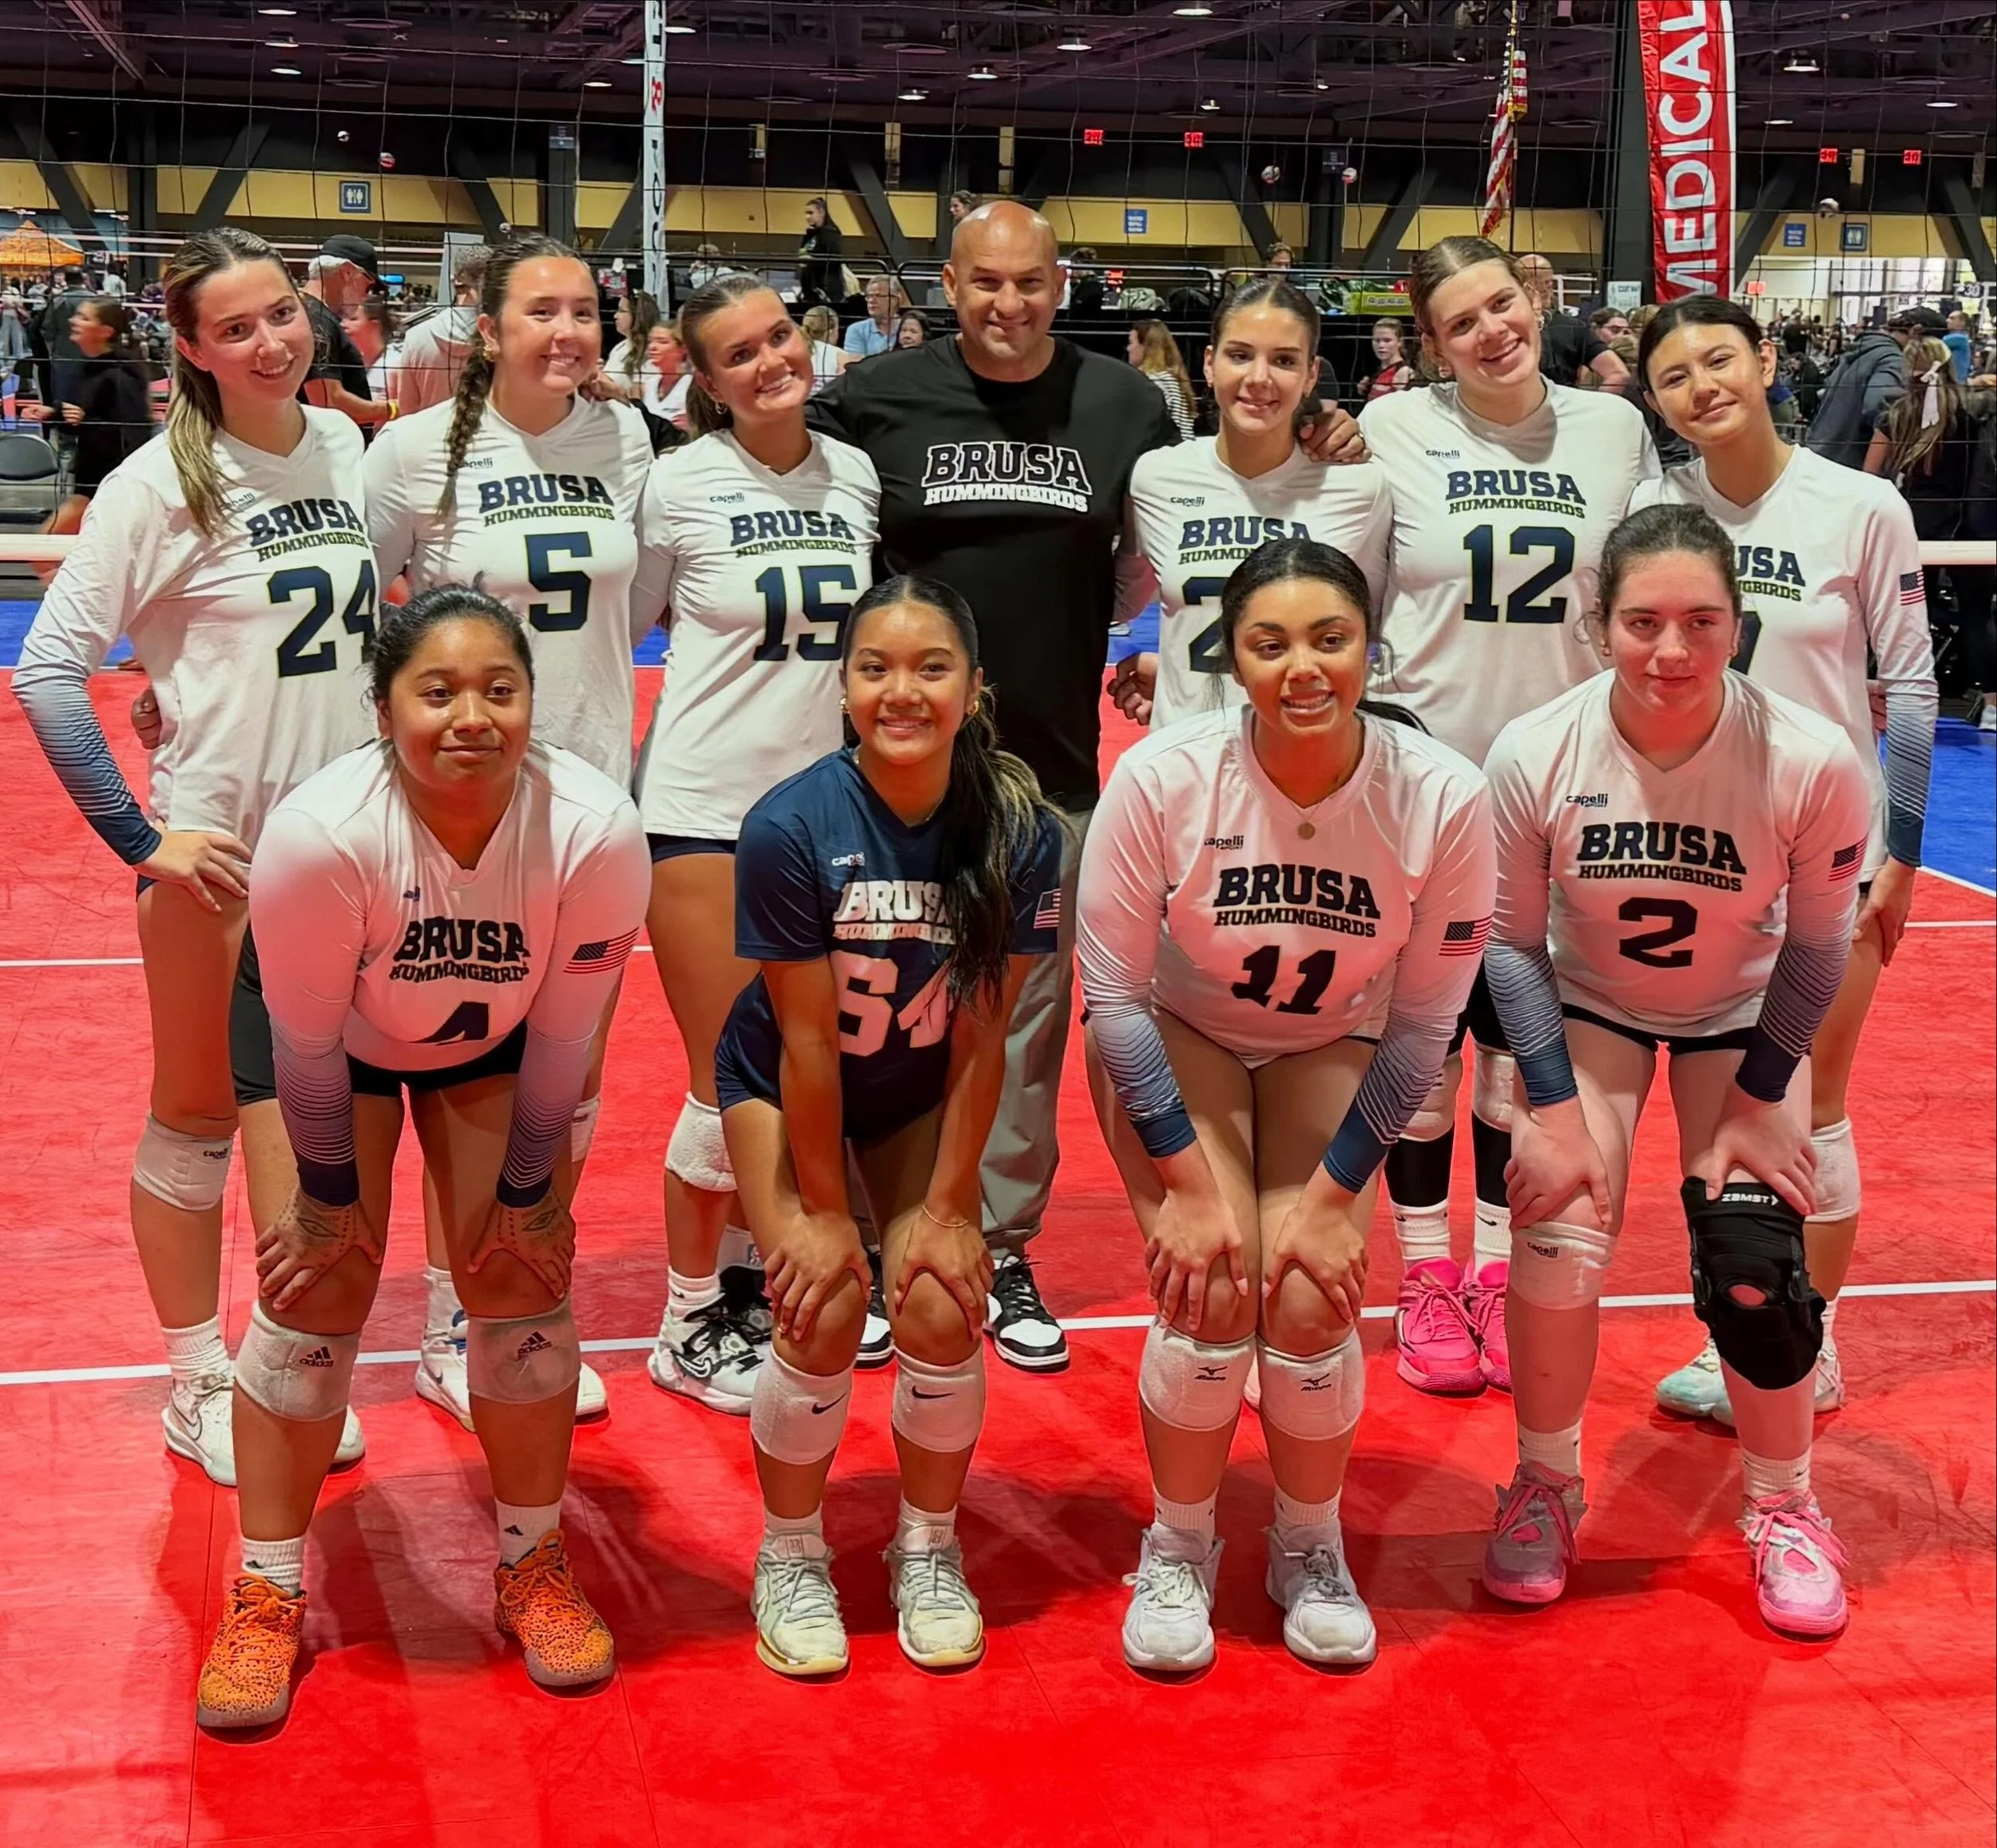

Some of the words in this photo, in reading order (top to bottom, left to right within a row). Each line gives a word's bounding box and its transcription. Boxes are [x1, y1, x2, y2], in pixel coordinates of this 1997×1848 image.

[1659, 0, 1717, 299] MEDICAL
[921, 441, 1093, 495] BRUSA
[1445, 470, 1586, 506] BRUSA
[478, 474, 614, 514] BRUSA
[484, 506, 615, 527] HUMMINGBIRDS
[923, 483, 1088, 512] HUMMINGBIRDS
[1448, 498, 1586, 519] HUMMINGBIRDS
[245, 499, 364, 547] BRUSA
[730, 510, 856, 547] BRUSA
[524, 531, 593, 632] 5
[1463, 524, 1575, 624] 12
[267, 559, 379, 678] 24
[754, 564, 857, 661] 15
[1566, 793, 1608, 805] capelli
[1205, 836, 1244, 848] capelli
[1576, 821, 1747, 875] BRUSA
[1213, 864, 1380, 919] BRUSA
[1578, 864, 1742, 892] HUMMINGBIRDS
[393, 916, 531, 963] BRUSA
[1214, 908, 1376, 937] HUMMINGBIRDS
[1619, 897, 1697, 968] 2
[1231, 945, 1336, 1015] 11
